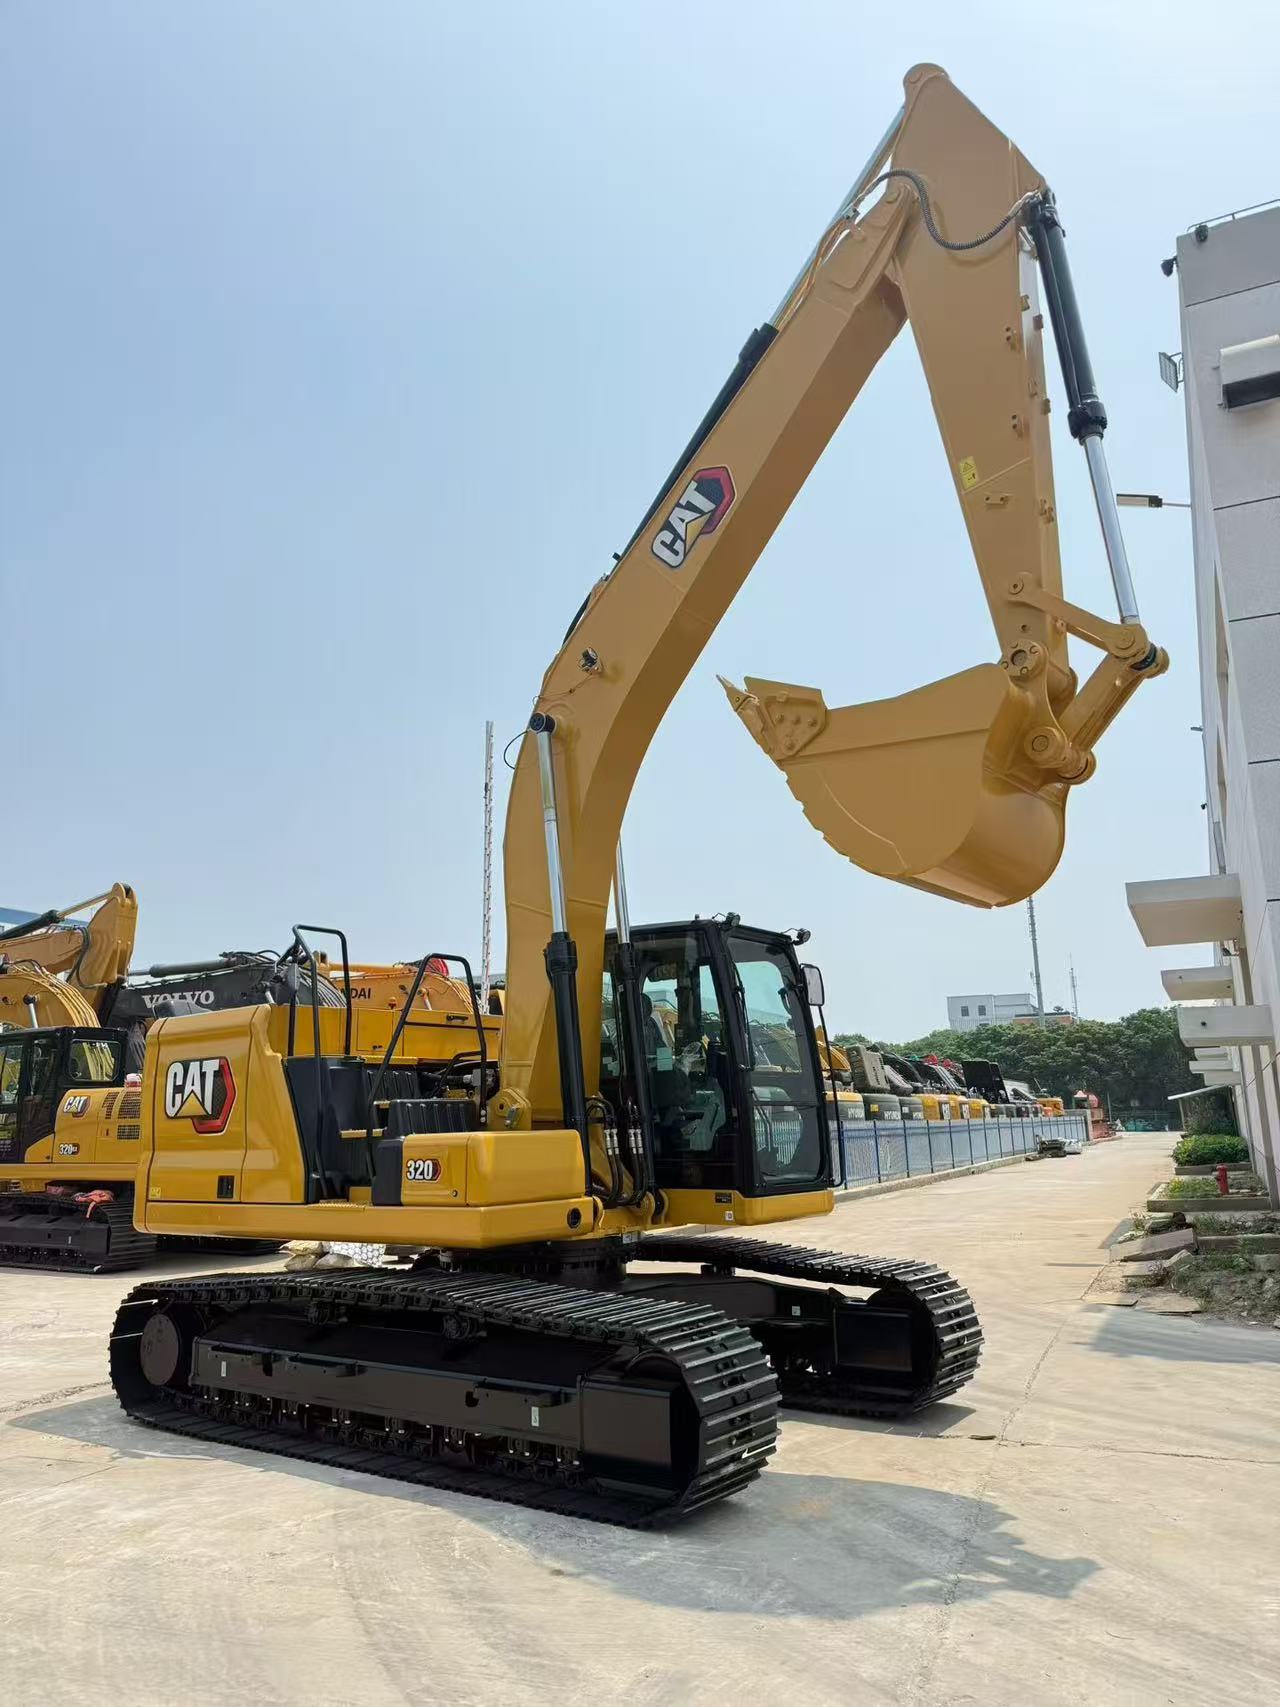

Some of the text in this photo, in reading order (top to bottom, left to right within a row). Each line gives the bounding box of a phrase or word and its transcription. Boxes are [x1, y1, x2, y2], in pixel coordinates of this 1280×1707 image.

[653, 480, 717, 567] CAT
[142, 990, 214, 1009] VOLVO
[165, 1058, 220, 1118] CAT
[63, 1096, 88, 1113] CAT
[406, 1159, 433, 1180] 320
